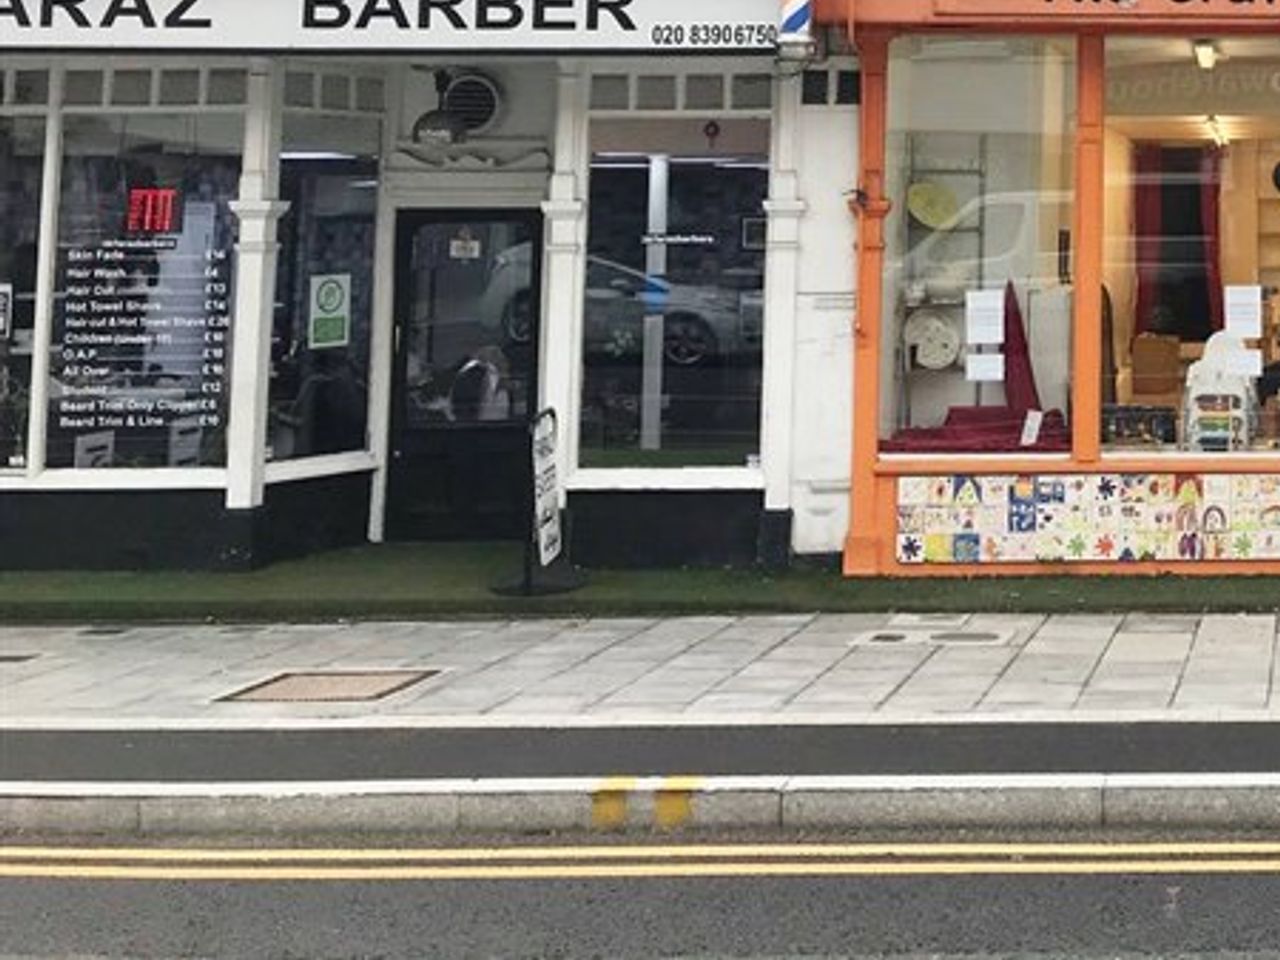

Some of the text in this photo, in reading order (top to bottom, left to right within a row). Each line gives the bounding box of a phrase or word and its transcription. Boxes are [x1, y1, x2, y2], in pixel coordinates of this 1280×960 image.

[651, 24, 778, 45] 020 83906750
[68, 250, 93, 260] Skin
[97, 250, 124, 260] Fade
[66, 269, 90, 279] Hair
[65, 301, 87, 312] Hot
[90, 301, 123, 311] Towel
[60, 401, 95, 412] Beard
[60, 416, 95, 427] Beard
[97, 416, 123, 427] Trim
[126, 416, 135, 426] &
